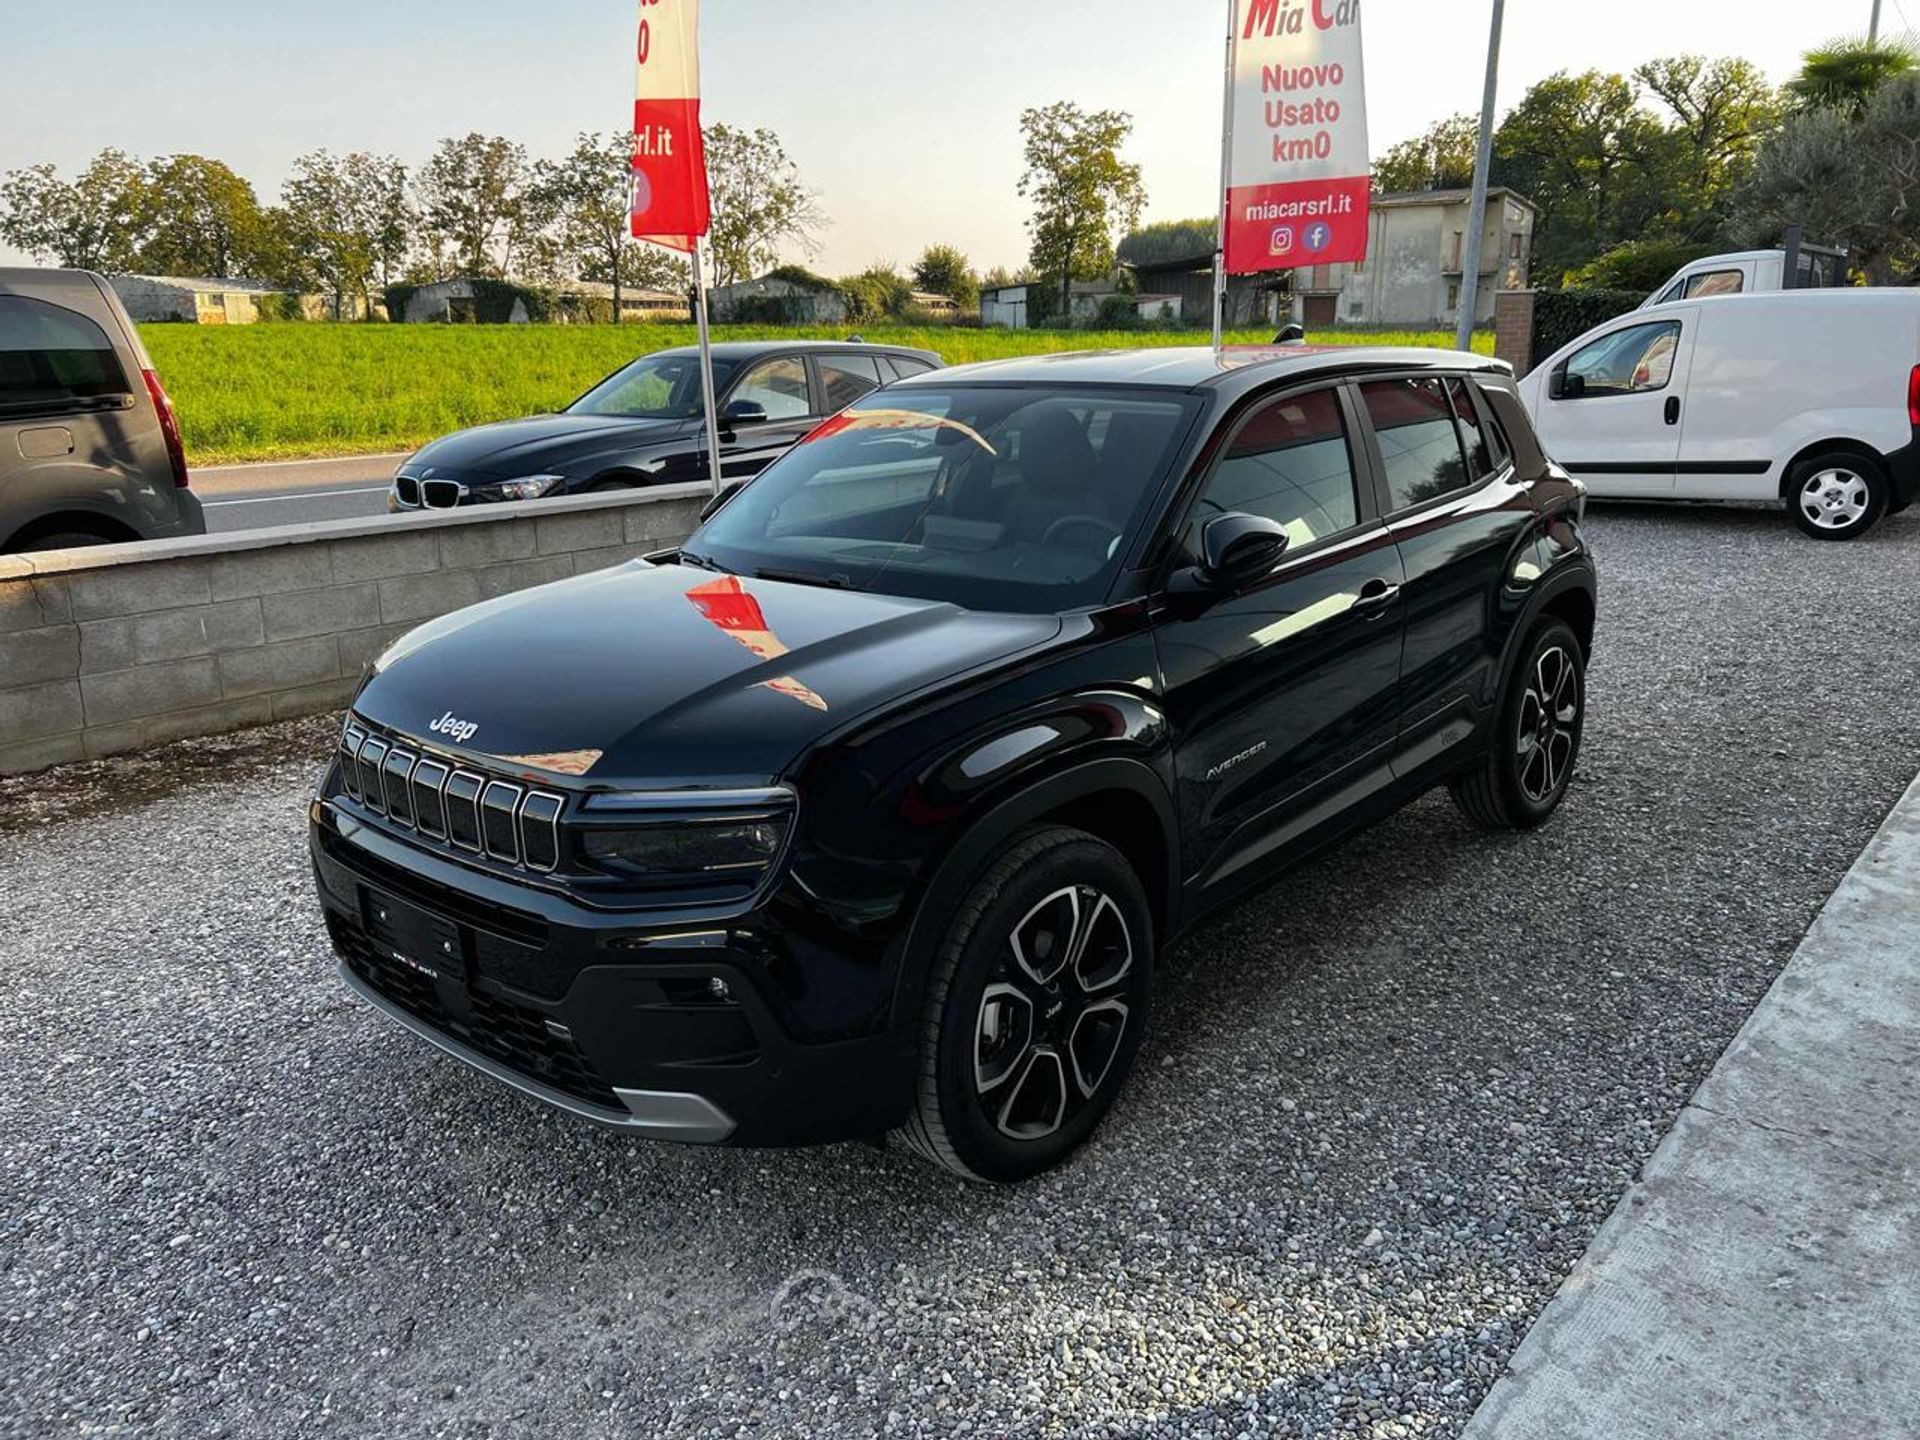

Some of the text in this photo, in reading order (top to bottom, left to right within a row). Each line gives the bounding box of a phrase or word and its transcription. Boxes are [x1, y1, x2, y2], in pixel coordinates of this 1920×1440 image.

[1242, 0, 1360, 39] Mia Car
[1261, 63, 1344, 93] Nuovo
[1264, 97, 1340, 128] Usato
[1245, 194, 1352, 221] miacarsrl.it
[429, 711, 479, 743] Jeep
[1206, 740, 1267, 781] AVENGER
